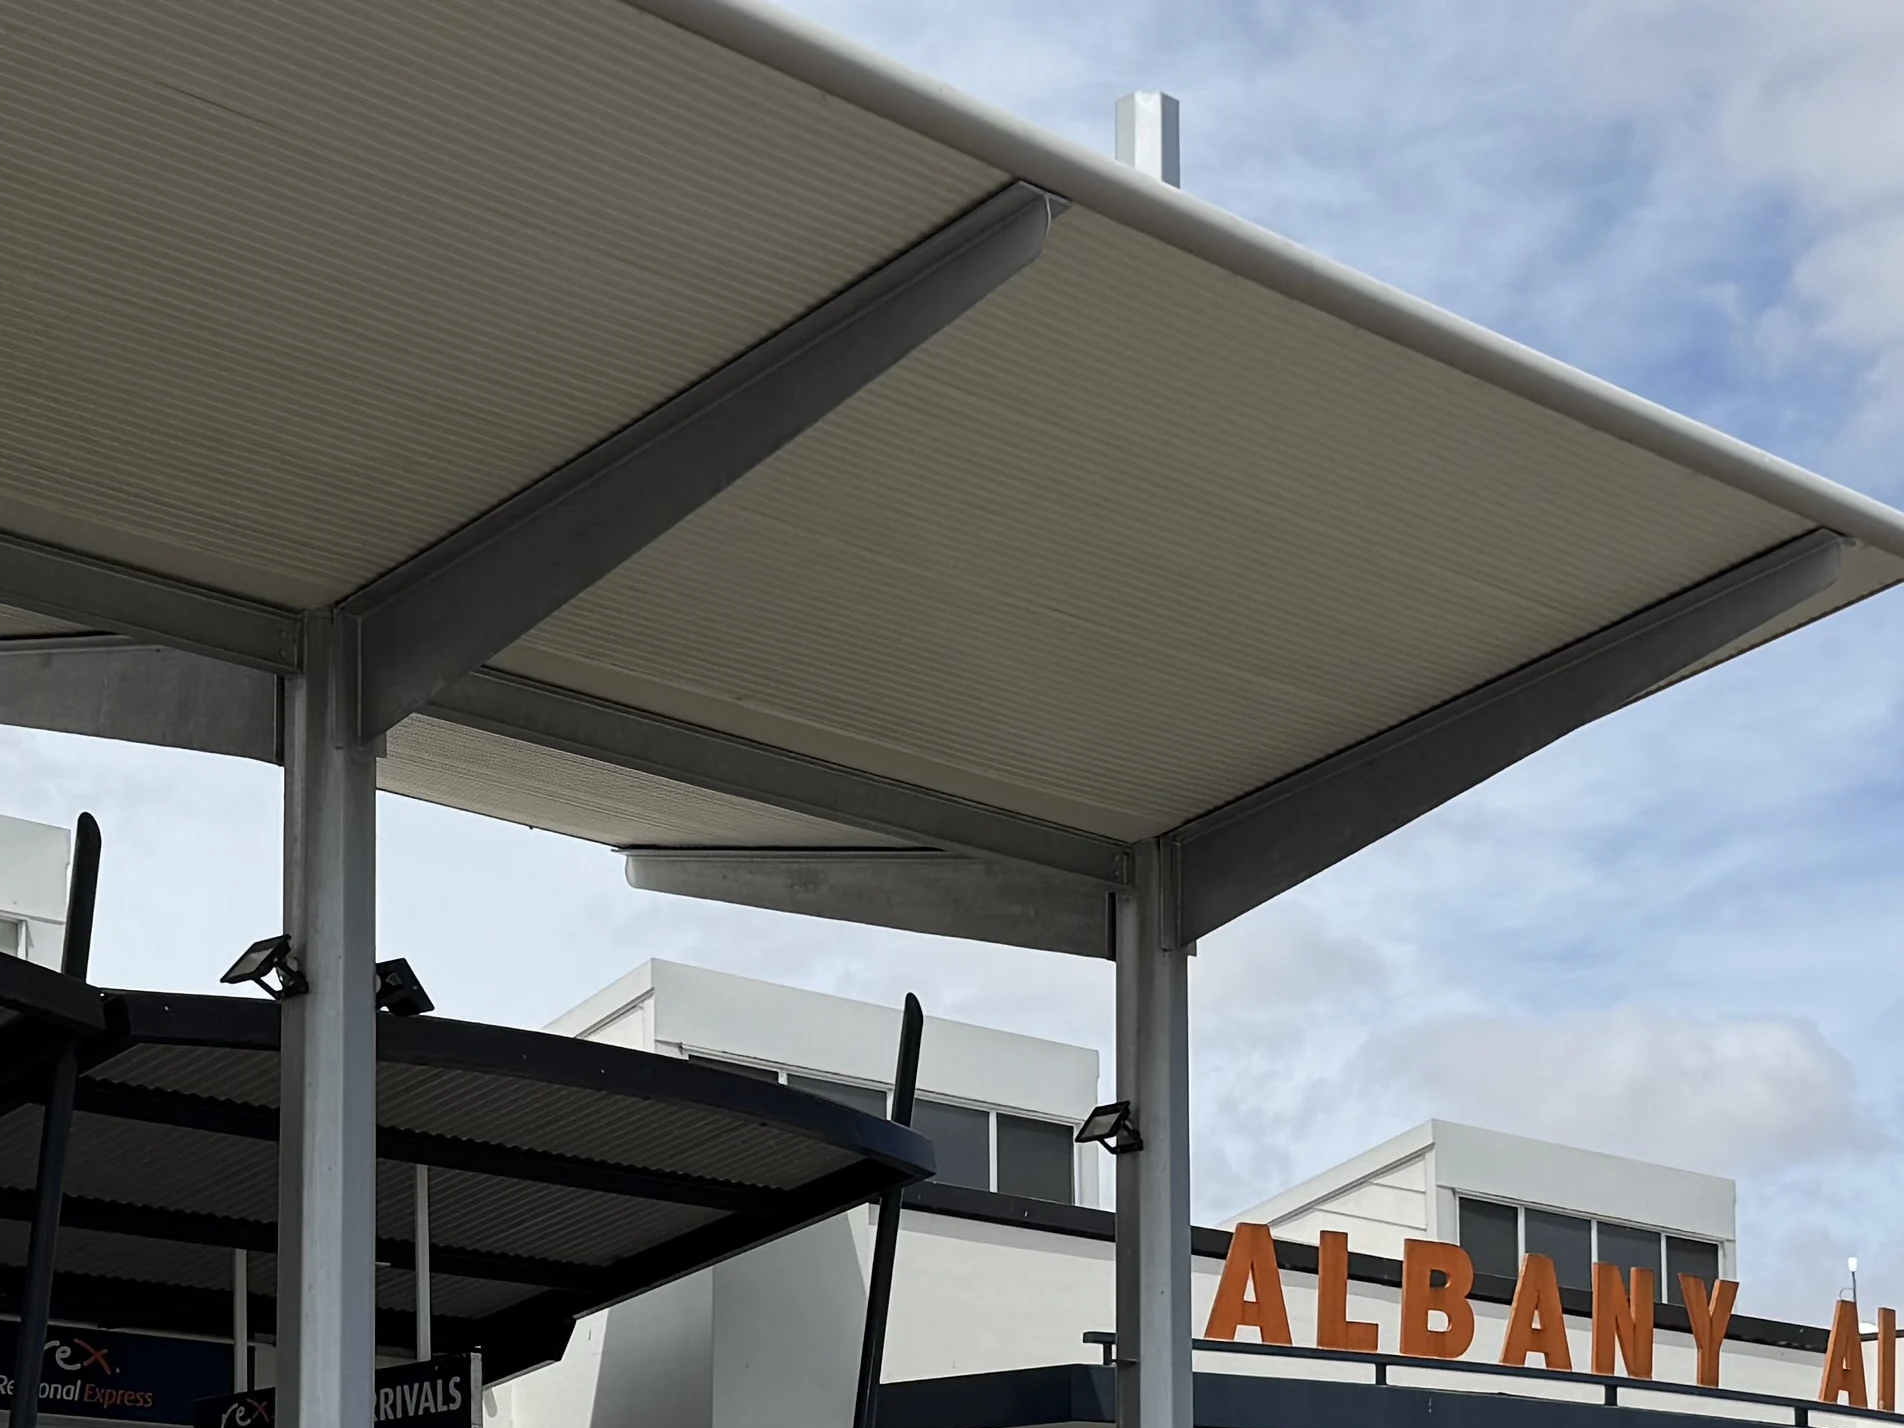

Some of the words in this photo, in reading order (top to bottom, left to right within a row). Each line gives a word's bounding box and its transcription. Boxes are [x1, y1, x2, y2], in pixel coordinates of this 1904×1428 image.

[1204, 1222, 1740, 1388] ALBANY
[84, 1383, 153, 1410] Express
[374, 1376, 462, 1422] RIVALS
